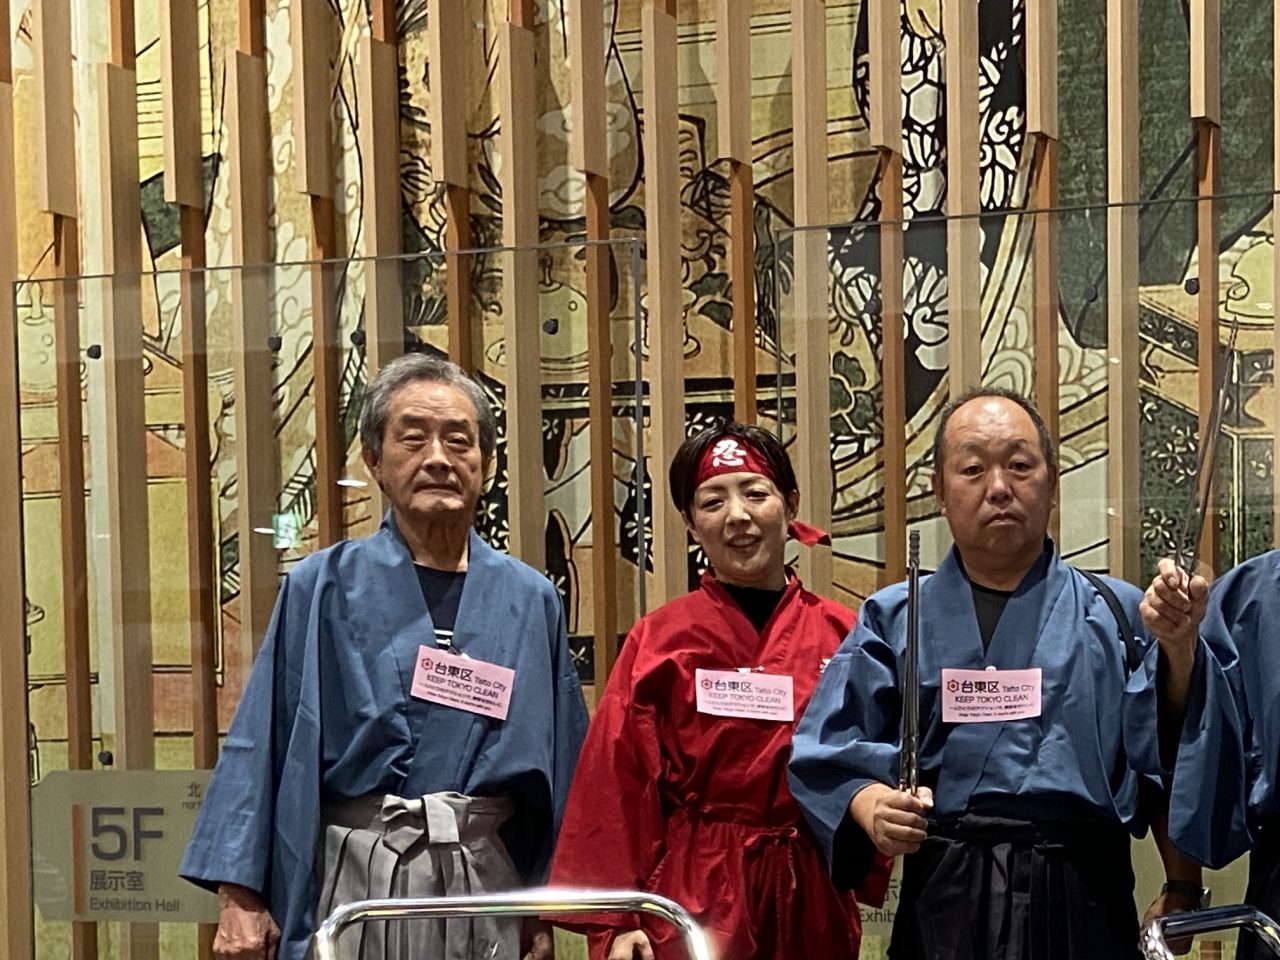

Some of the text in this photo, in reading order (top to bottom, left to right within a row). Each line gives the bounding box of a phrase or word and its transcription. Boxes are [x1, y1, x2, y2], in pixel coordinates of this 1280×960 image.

[713, 439, 747, 467] 忍
[435, 662, 507, 692] 台東区 Taito City
[426, 675, 446, 686] KEEP
[447, 679, 472, 692] TOKYO
[474, 686, 499, 699] CLEAN
[715, 680, 787, 696] 台東区 Taito City
[961, 680, 1035, 694] 台東区 Taito City
[708, 692, 781, 704] KEEP TOKYO CLEAN
[955, 694, 1029, 703] KEEP TOKYO CLEAN
[187, 781, 201, 798] 北
[91, 806, 164, 862] 5F
[90, 870, 144, 891] 展示室
[90, 897, 180, 912] Exhibition Hall
